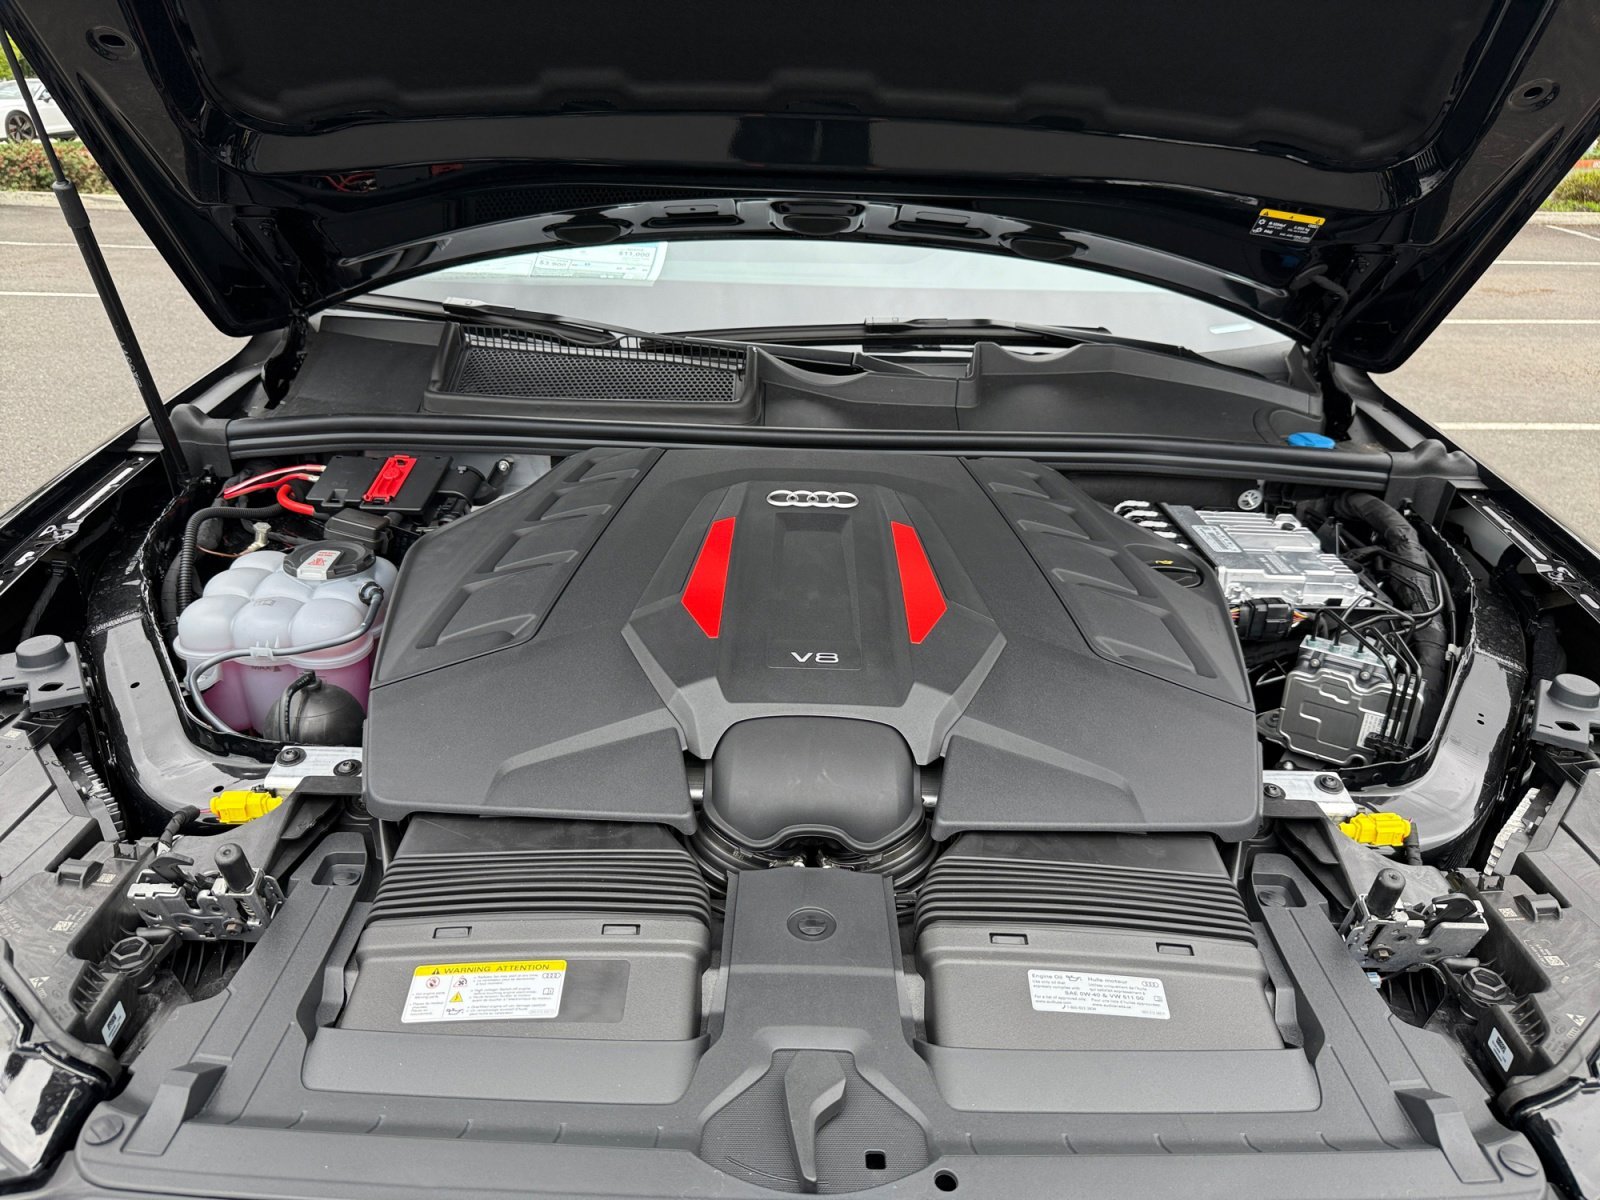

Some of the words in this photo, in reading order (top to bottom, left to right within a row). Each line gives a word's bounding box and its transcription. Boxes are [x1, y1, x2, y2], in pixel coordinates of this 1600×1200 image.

[791, 651, 839, 663] V8
[444, 965, 491, 974] WARNING
[494, 963, 550, 972] ATTENTION
